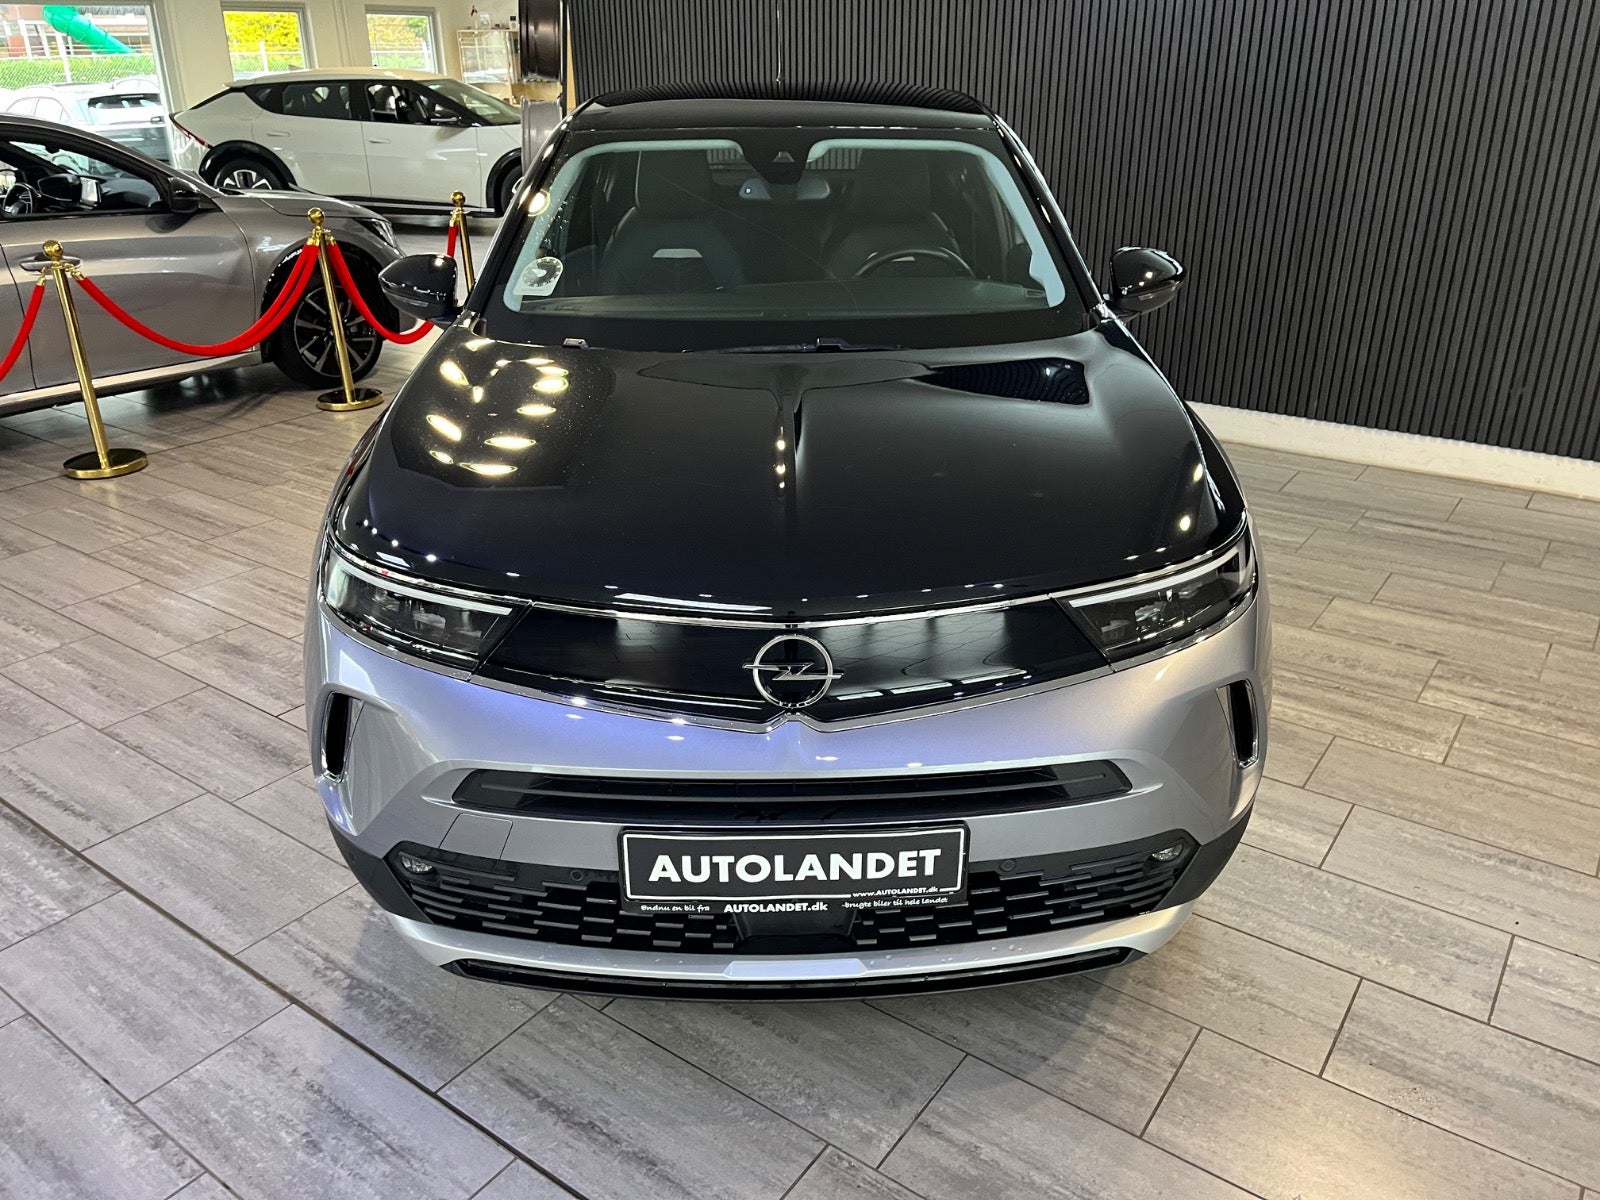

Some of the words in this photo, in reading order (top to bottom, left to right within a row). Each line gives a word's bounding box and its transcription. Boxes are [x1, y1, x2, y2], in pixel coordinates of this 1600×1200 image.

[648, 848, 942, 883] AUTOLANDET
[852, 886, 939, 897] www.AUTOLANDET.dk
[697, 904, 710, 913] fra
[723, 901, 828, 913] AUTOLANDET.dk
[873, 899, 892, 907] biler
[893, 898, 903, 906] til
